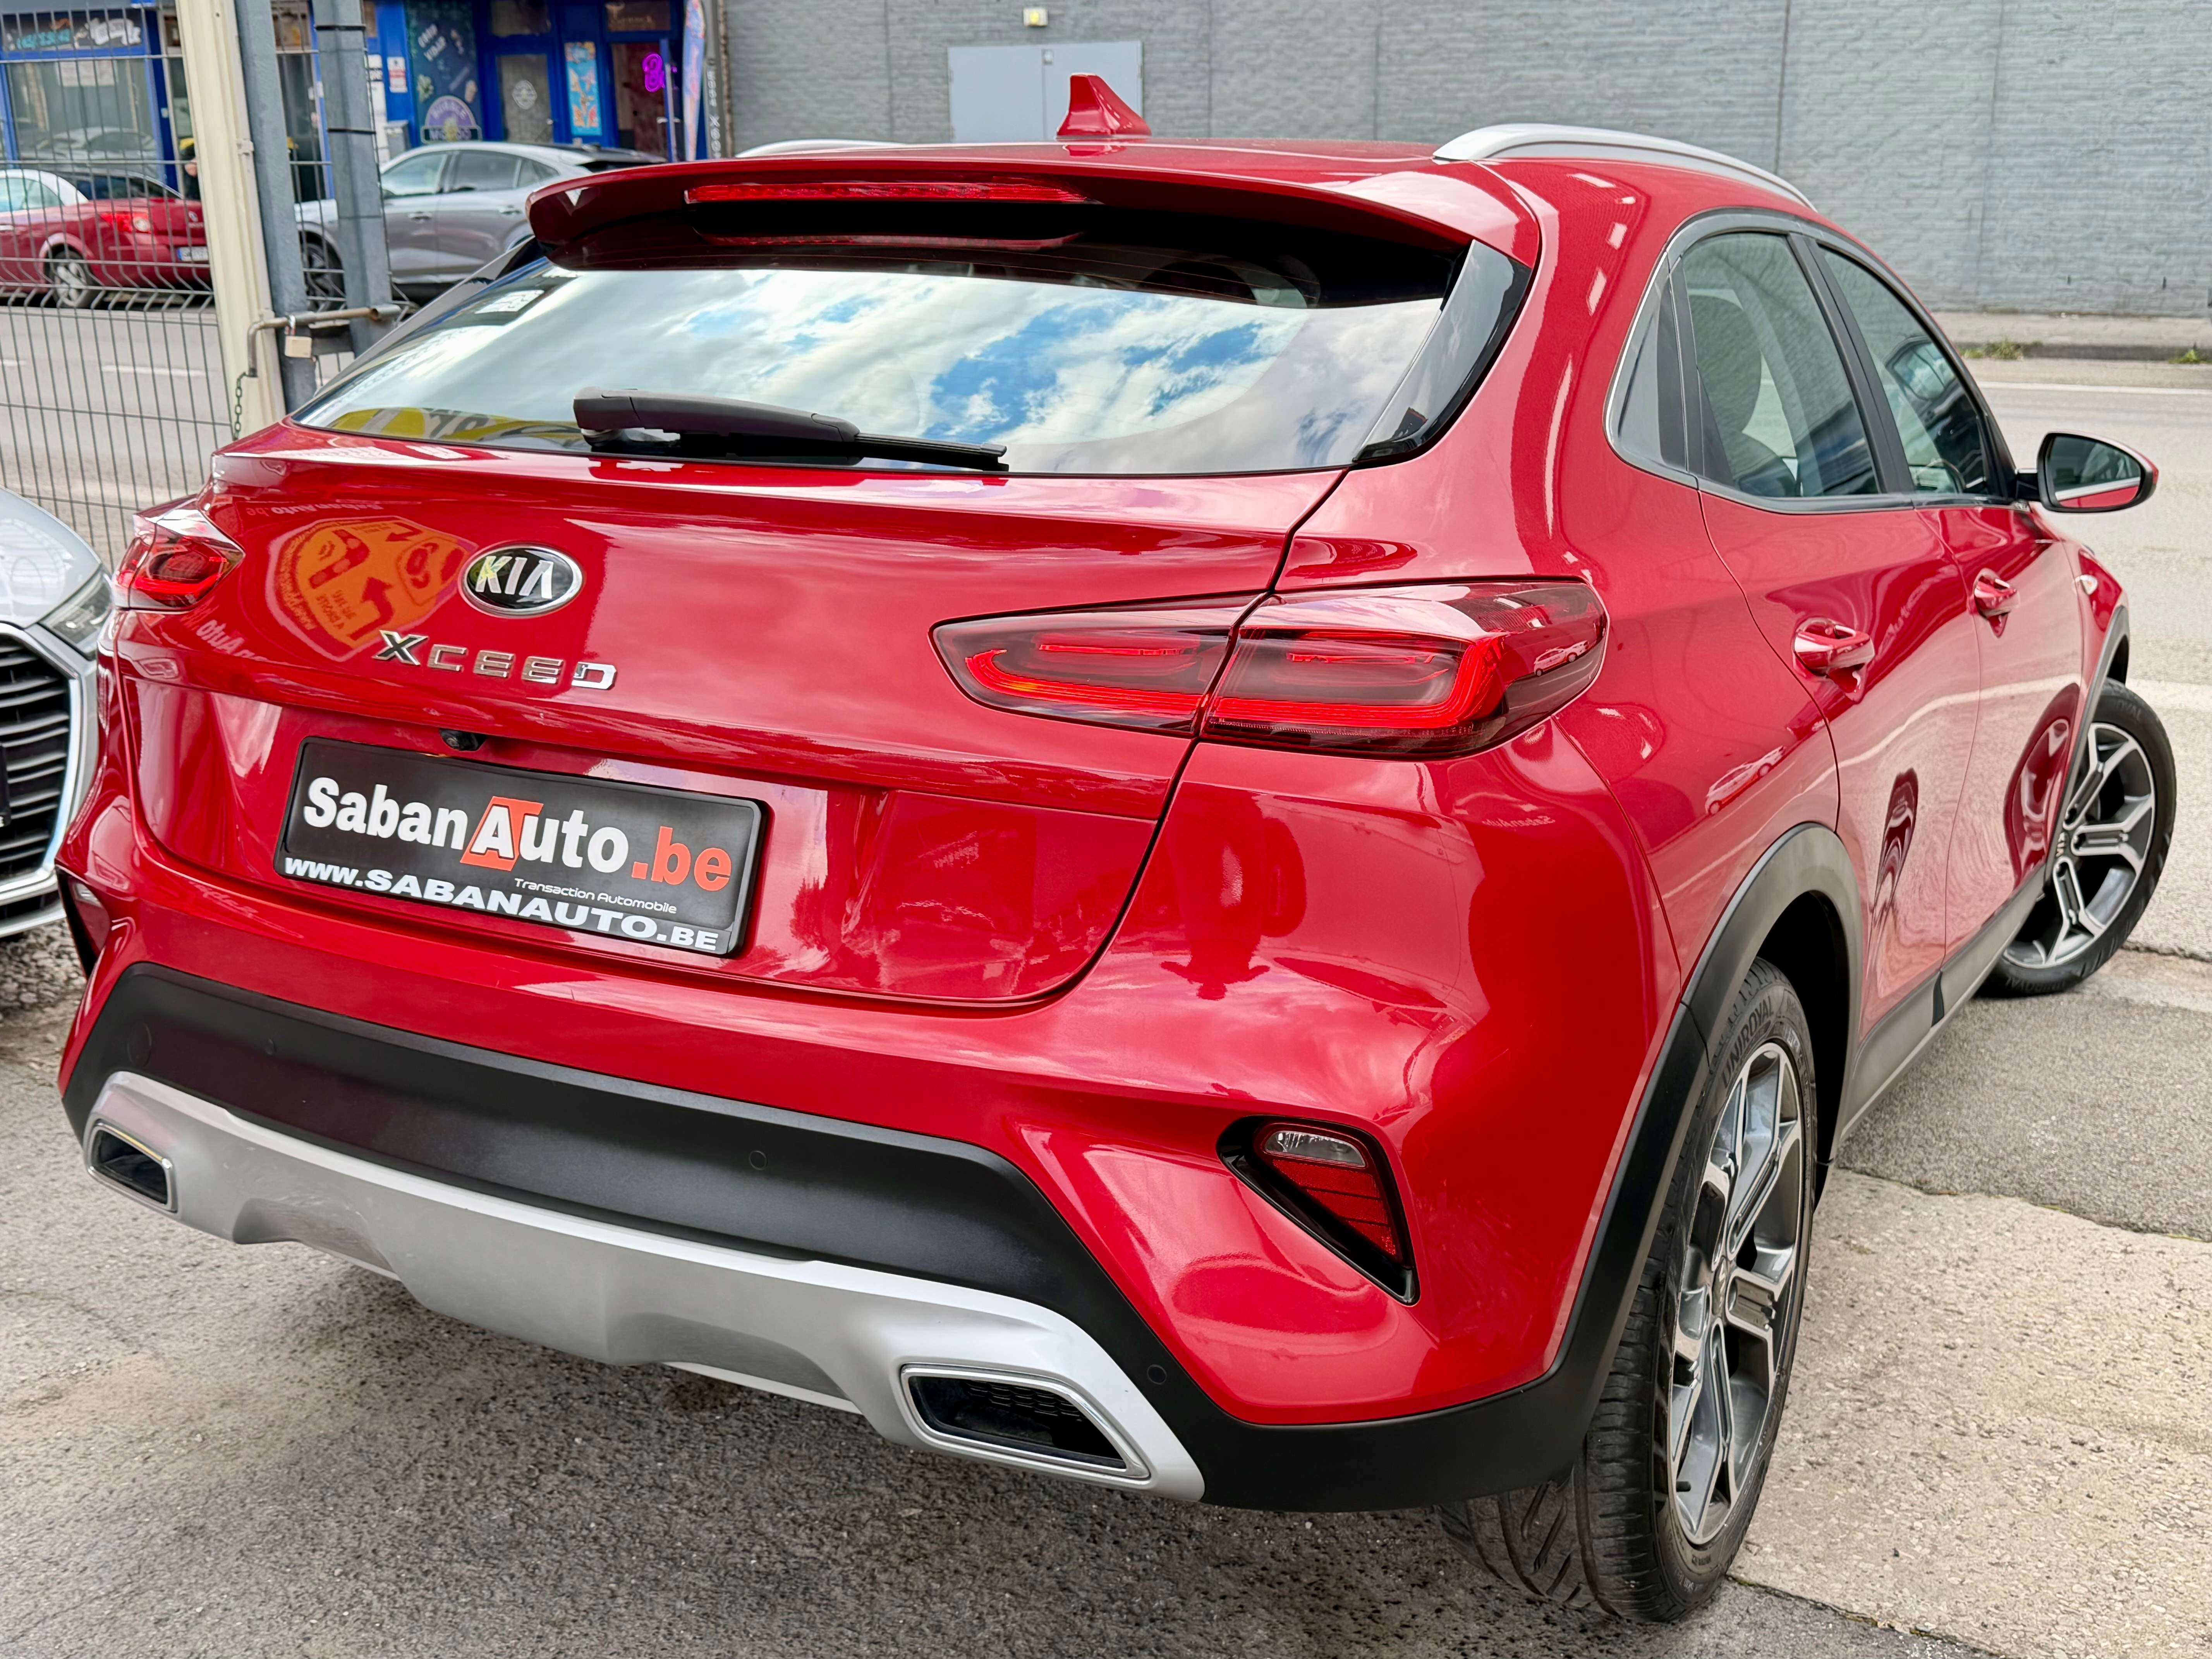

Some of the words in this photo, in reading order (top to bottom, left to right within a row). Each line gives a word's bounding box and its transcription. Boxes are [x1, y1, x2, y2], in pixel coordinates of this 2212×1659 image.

[475, 556, 554, 599] KIA
[372, 630, 617, 690] XCEED
[514, 878, 595, 900] Transaction
[597, 892, 677, 914] Automobile
[1722, 995, 1774, 1089] UNIROYAL
